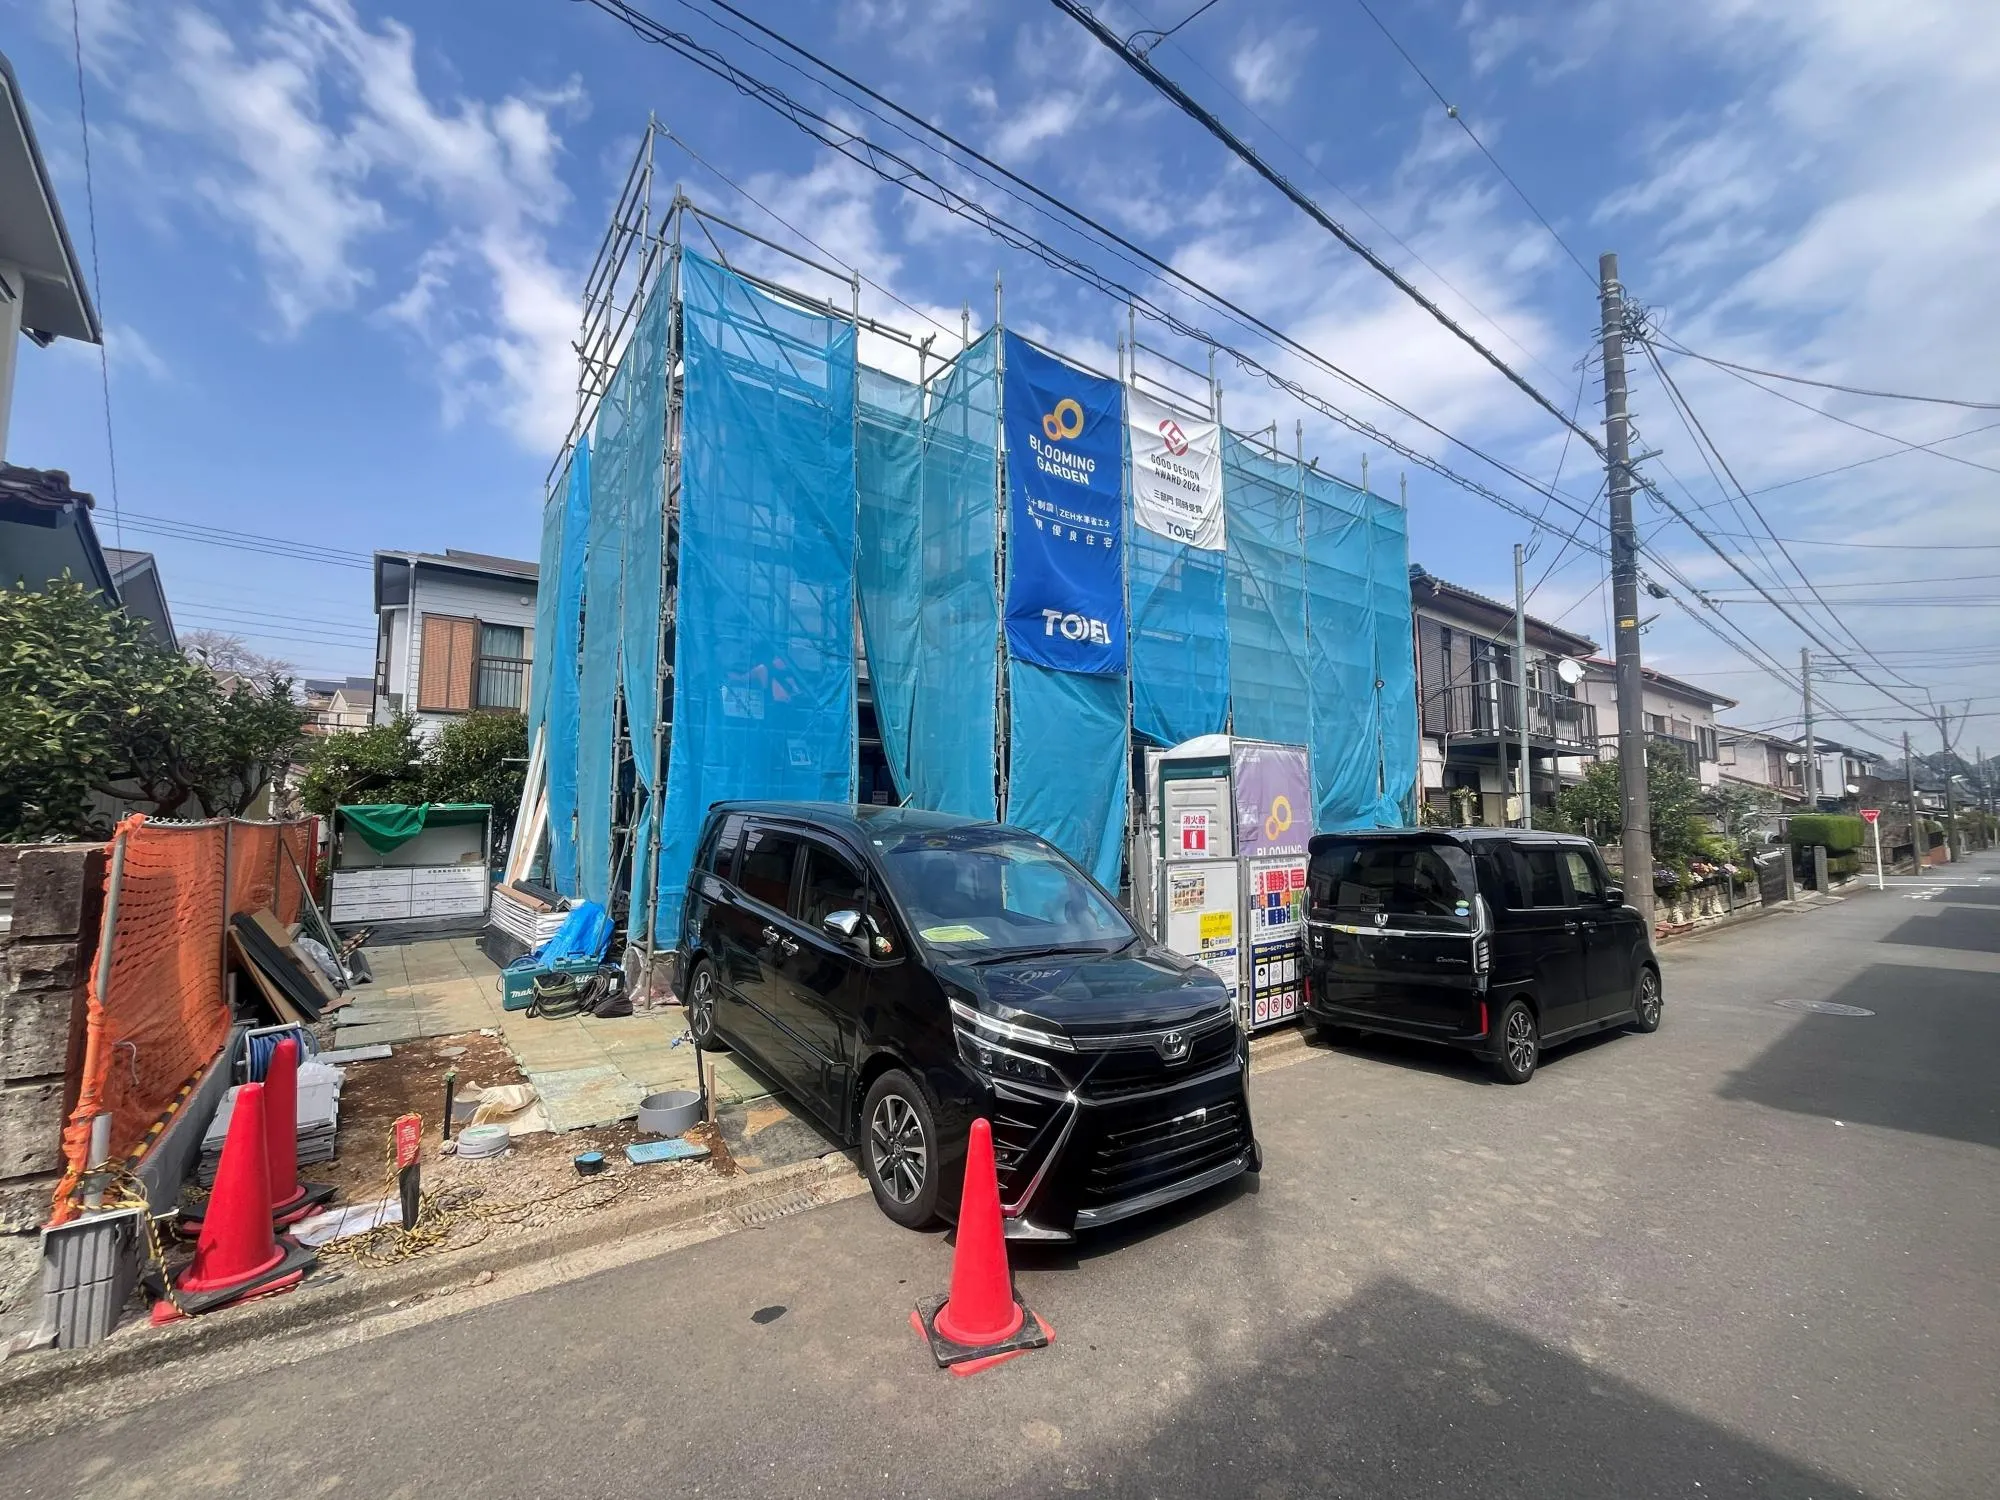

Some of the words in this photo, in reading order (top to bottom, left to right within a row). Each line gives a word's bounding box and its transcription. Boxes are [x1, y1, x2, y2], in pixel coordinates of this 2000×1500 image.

[1029, 434, 1096, 472] BLOOMING
[1037, 456, 1090, 486] GARDEN
[1150, 454, 1172, 469] GOOD
[1173, 463, 1200, 481] DESIGN
[1154, 468, 1182, 485] AWARD
[1182, 479, 1200, 493] 2024
[1183, 815, 1206, 825] 消火器
